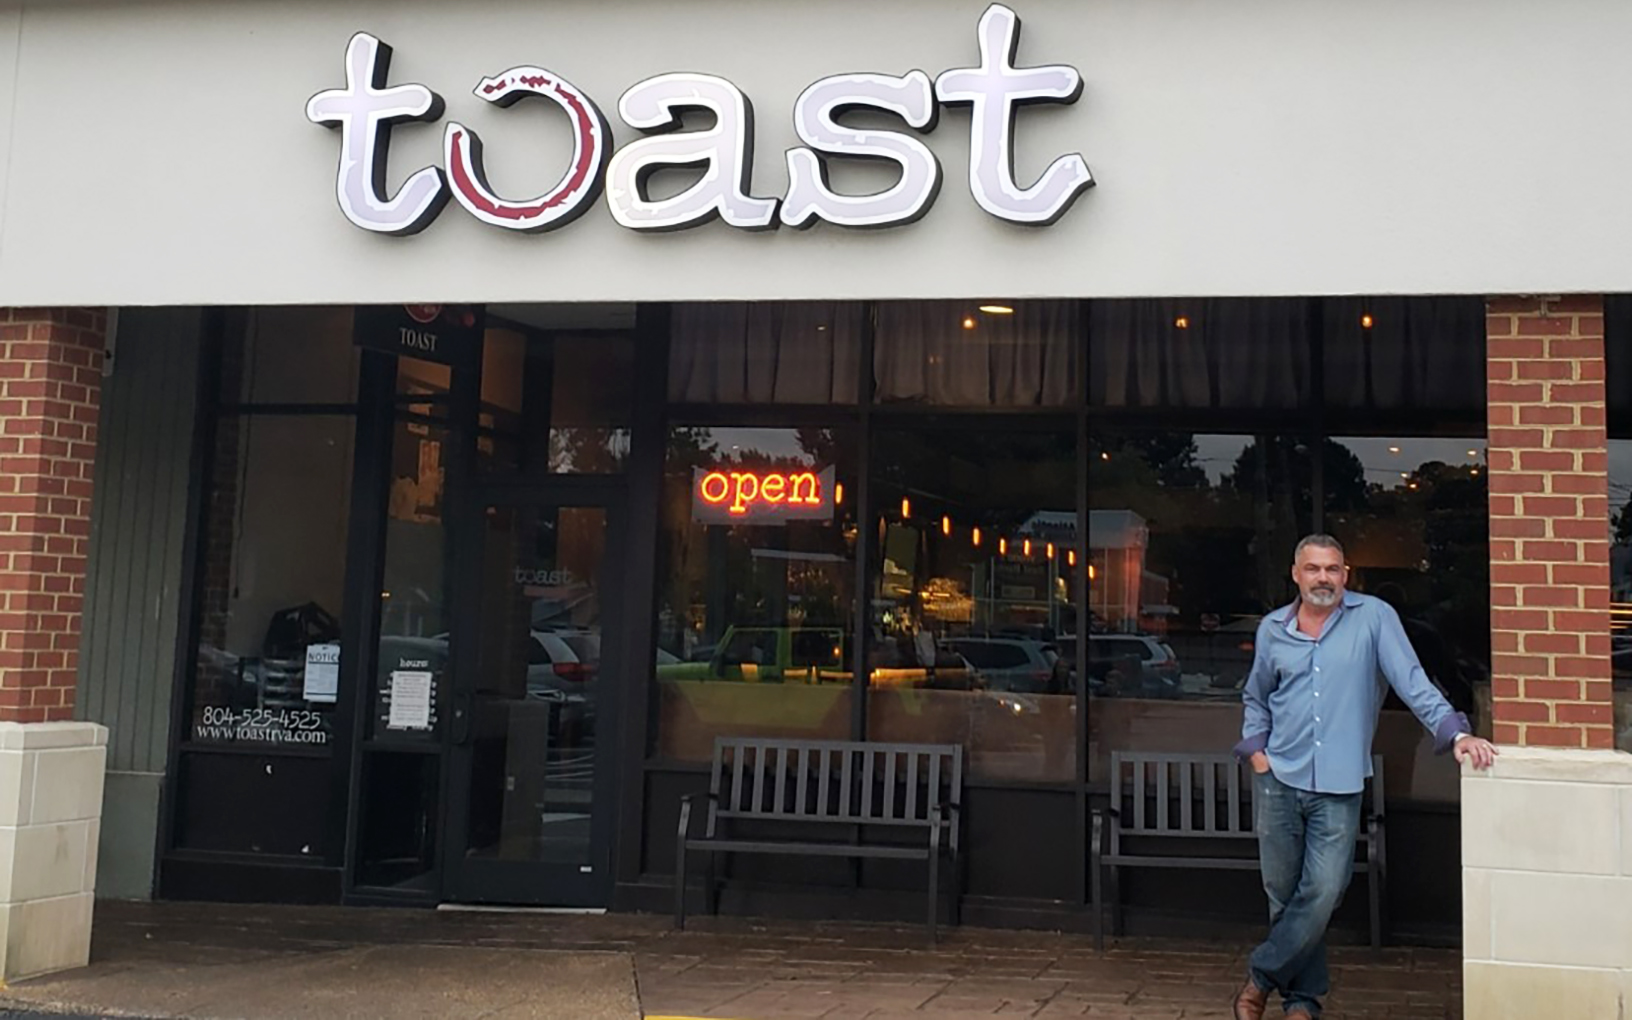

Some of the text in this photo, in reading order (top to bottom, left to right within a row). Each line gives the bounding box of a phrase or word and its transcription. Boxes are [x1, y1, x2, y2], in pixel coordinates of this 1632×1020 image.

[305, 3, 1096, 235] toast
[400, 327, 437, 351] TOAST
[700, 472, 821, 514] open
[514, 566, 573, 585] toast
[308, 652, 338, 663] NOTIC
[400, 657, 429, 668] hours
[202, 706, 321, 730] 804-525-4525
